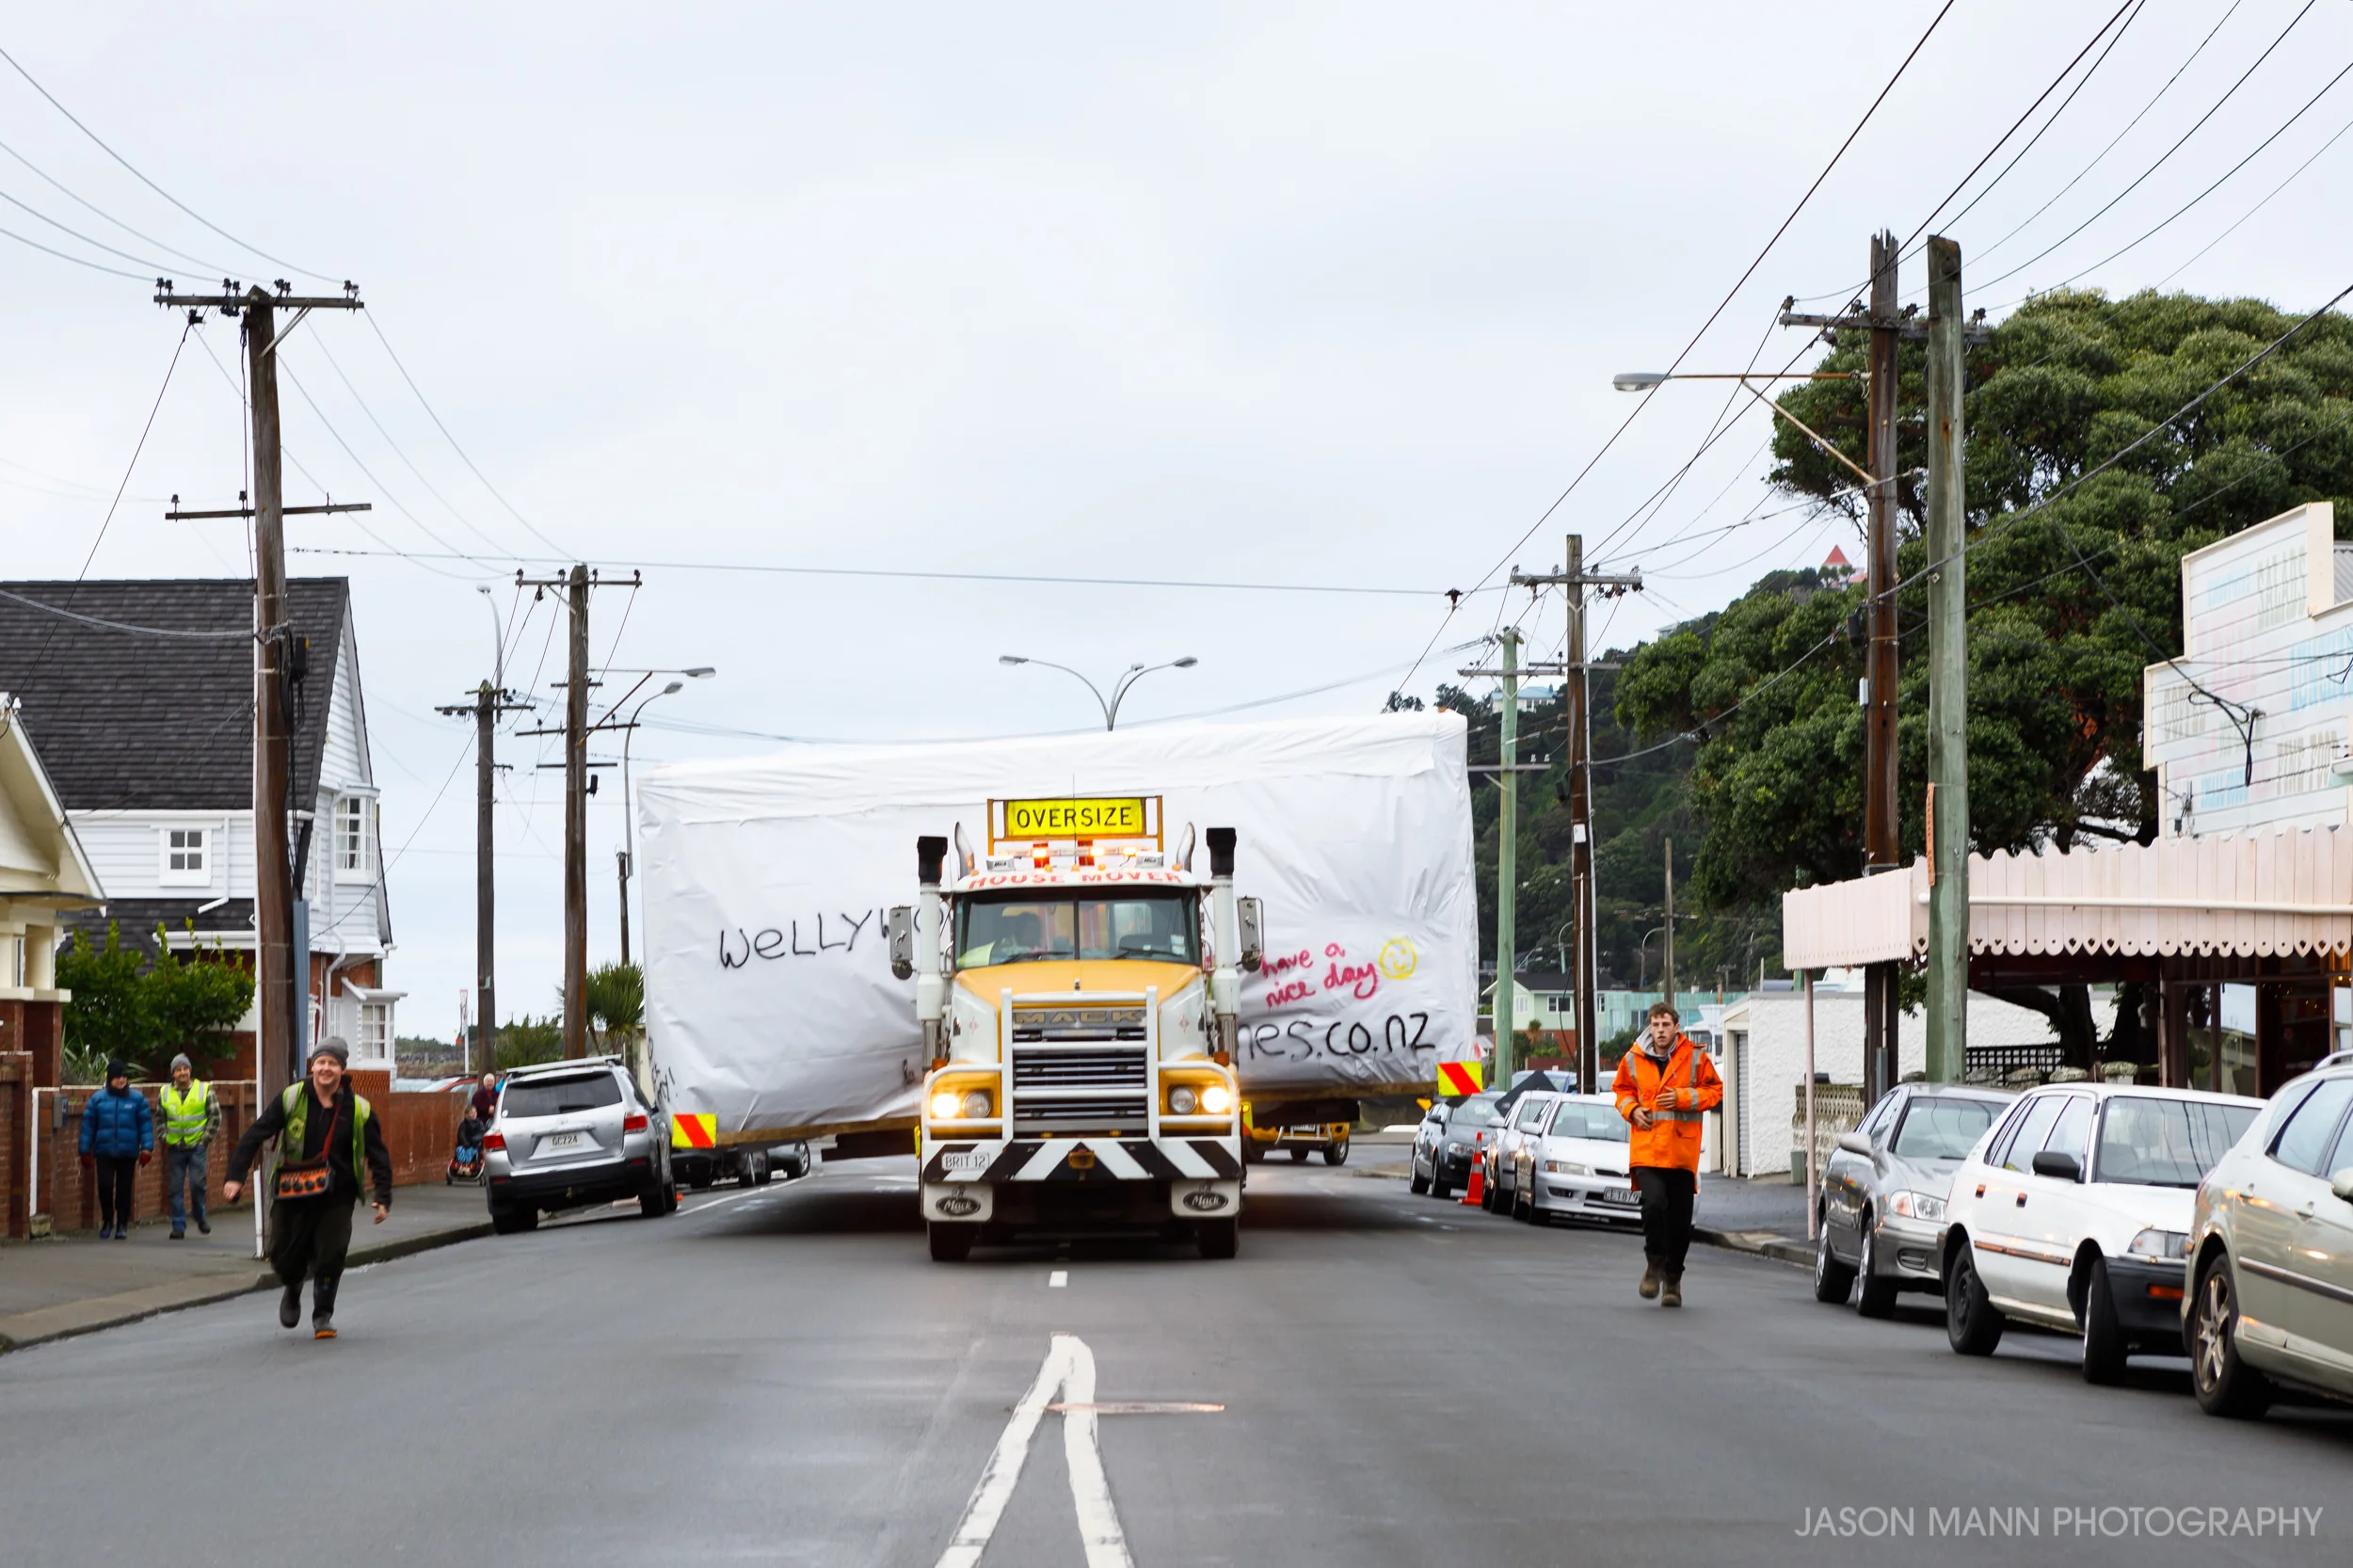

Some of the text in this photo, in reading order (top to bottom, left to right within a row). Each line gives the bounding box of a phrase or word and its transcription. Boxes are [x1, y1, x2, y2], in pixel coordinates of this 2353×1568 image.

[1016, 807, 1133, 828] OVERSIZE
[968, 870, 1183, 889] HOUSE MOVER
[1261, 942, 1345, 979] have a
[1266, 962, 1379, 1008] nice day
[1015, 1010, 1142, 1025] MACK
[945, 1155, 986, 1168] BRIT 12
[943, 1199, 972, 1212] Mack
[1192, 1195, 1221, 1207] Mack
